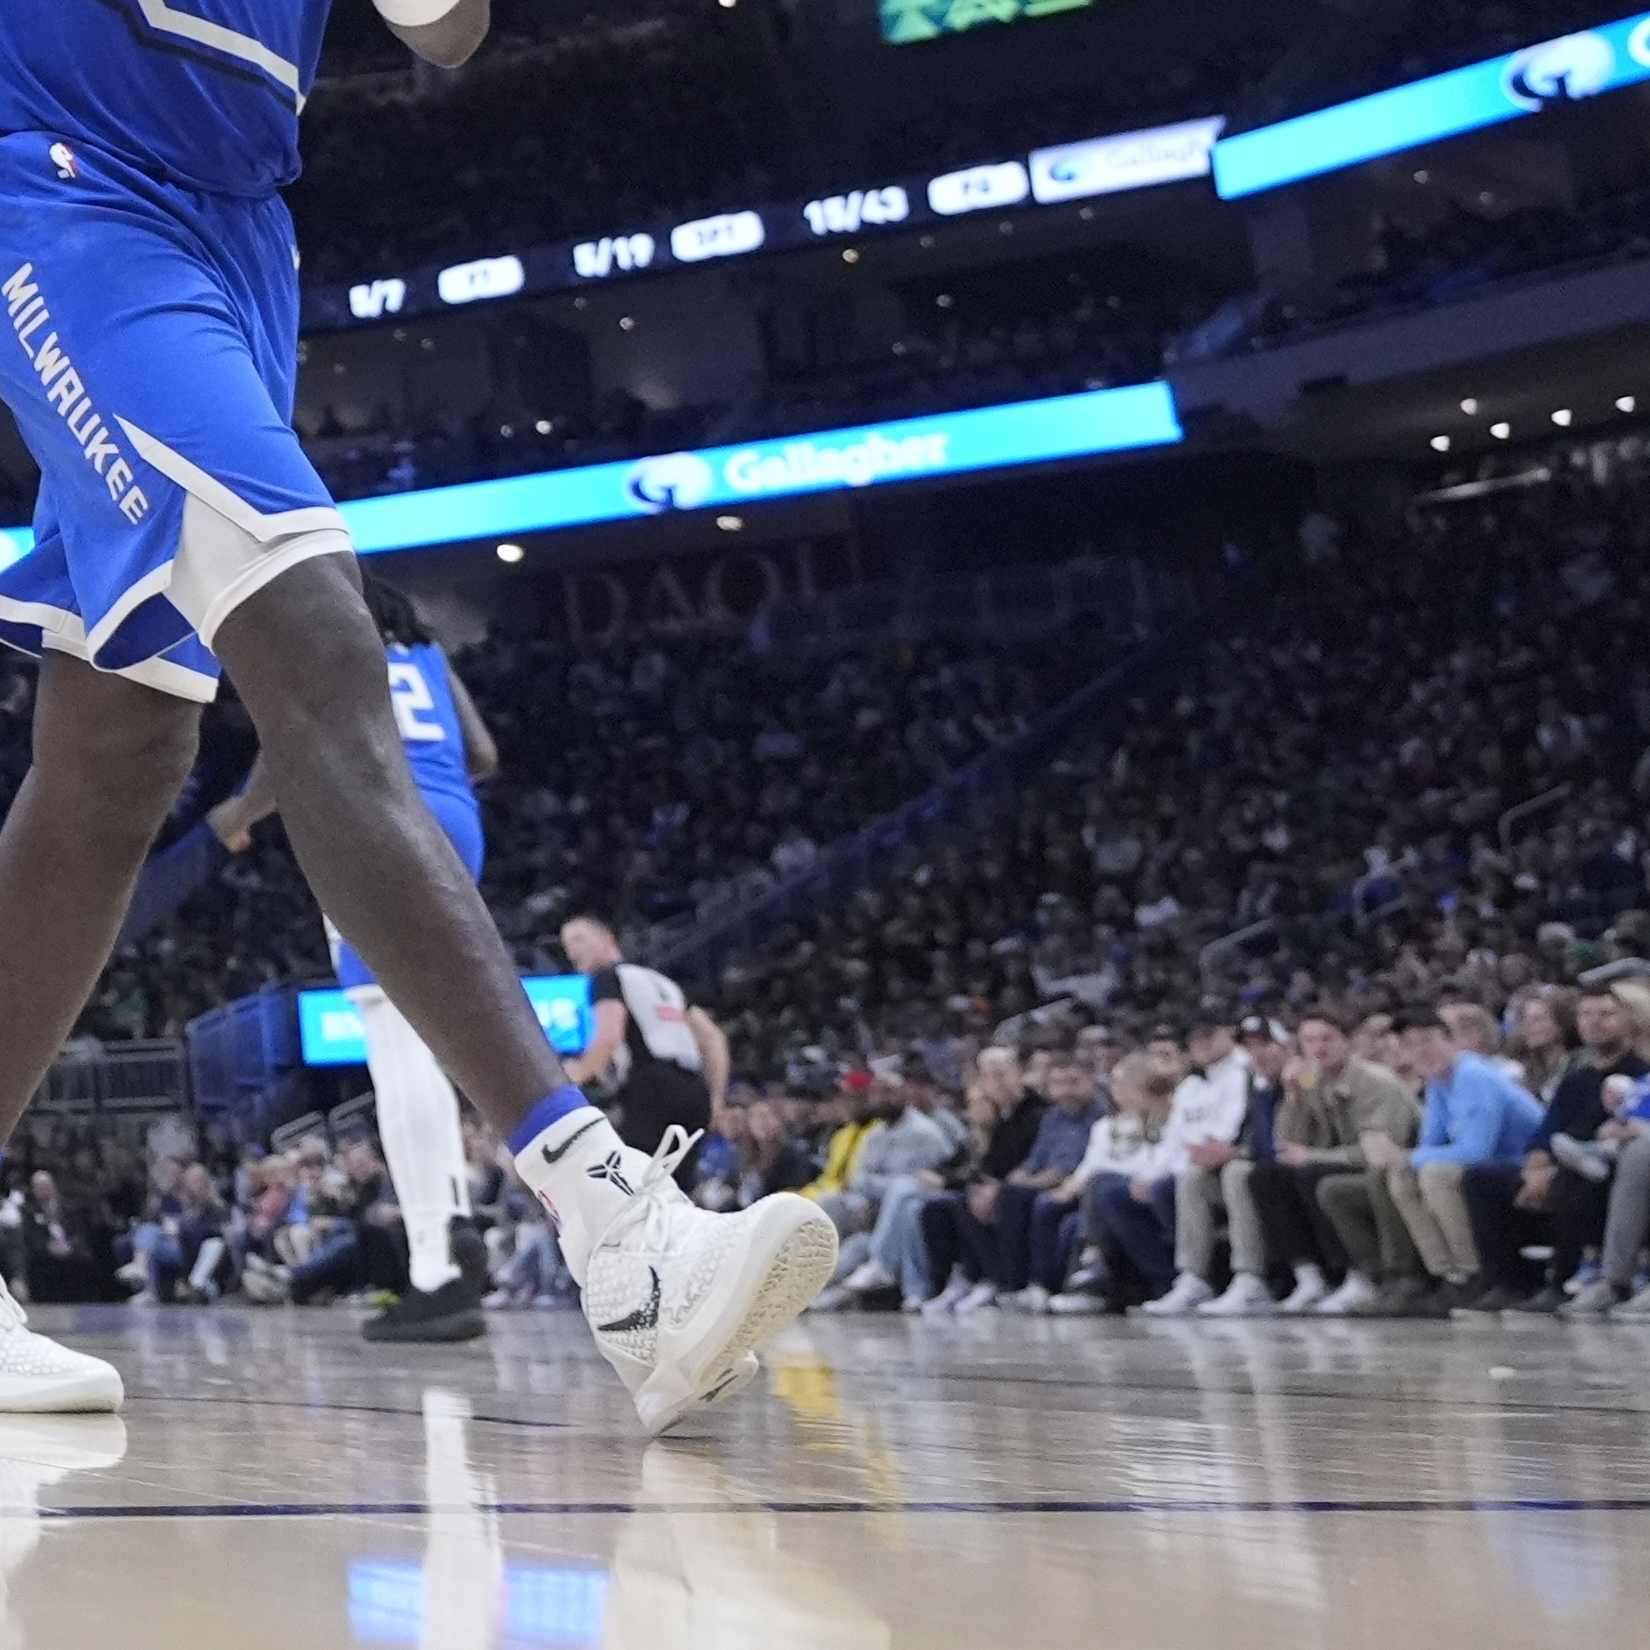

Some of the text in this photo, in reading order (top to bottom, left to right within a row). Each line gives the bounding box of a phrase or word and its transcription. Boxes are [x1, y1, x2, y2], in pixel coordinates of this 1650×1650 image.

[804, 185, 910, 236] 15/43
[0, 262, 153, 526] MILWAUKEE
[723, 431, 949, 488] Gallagher
